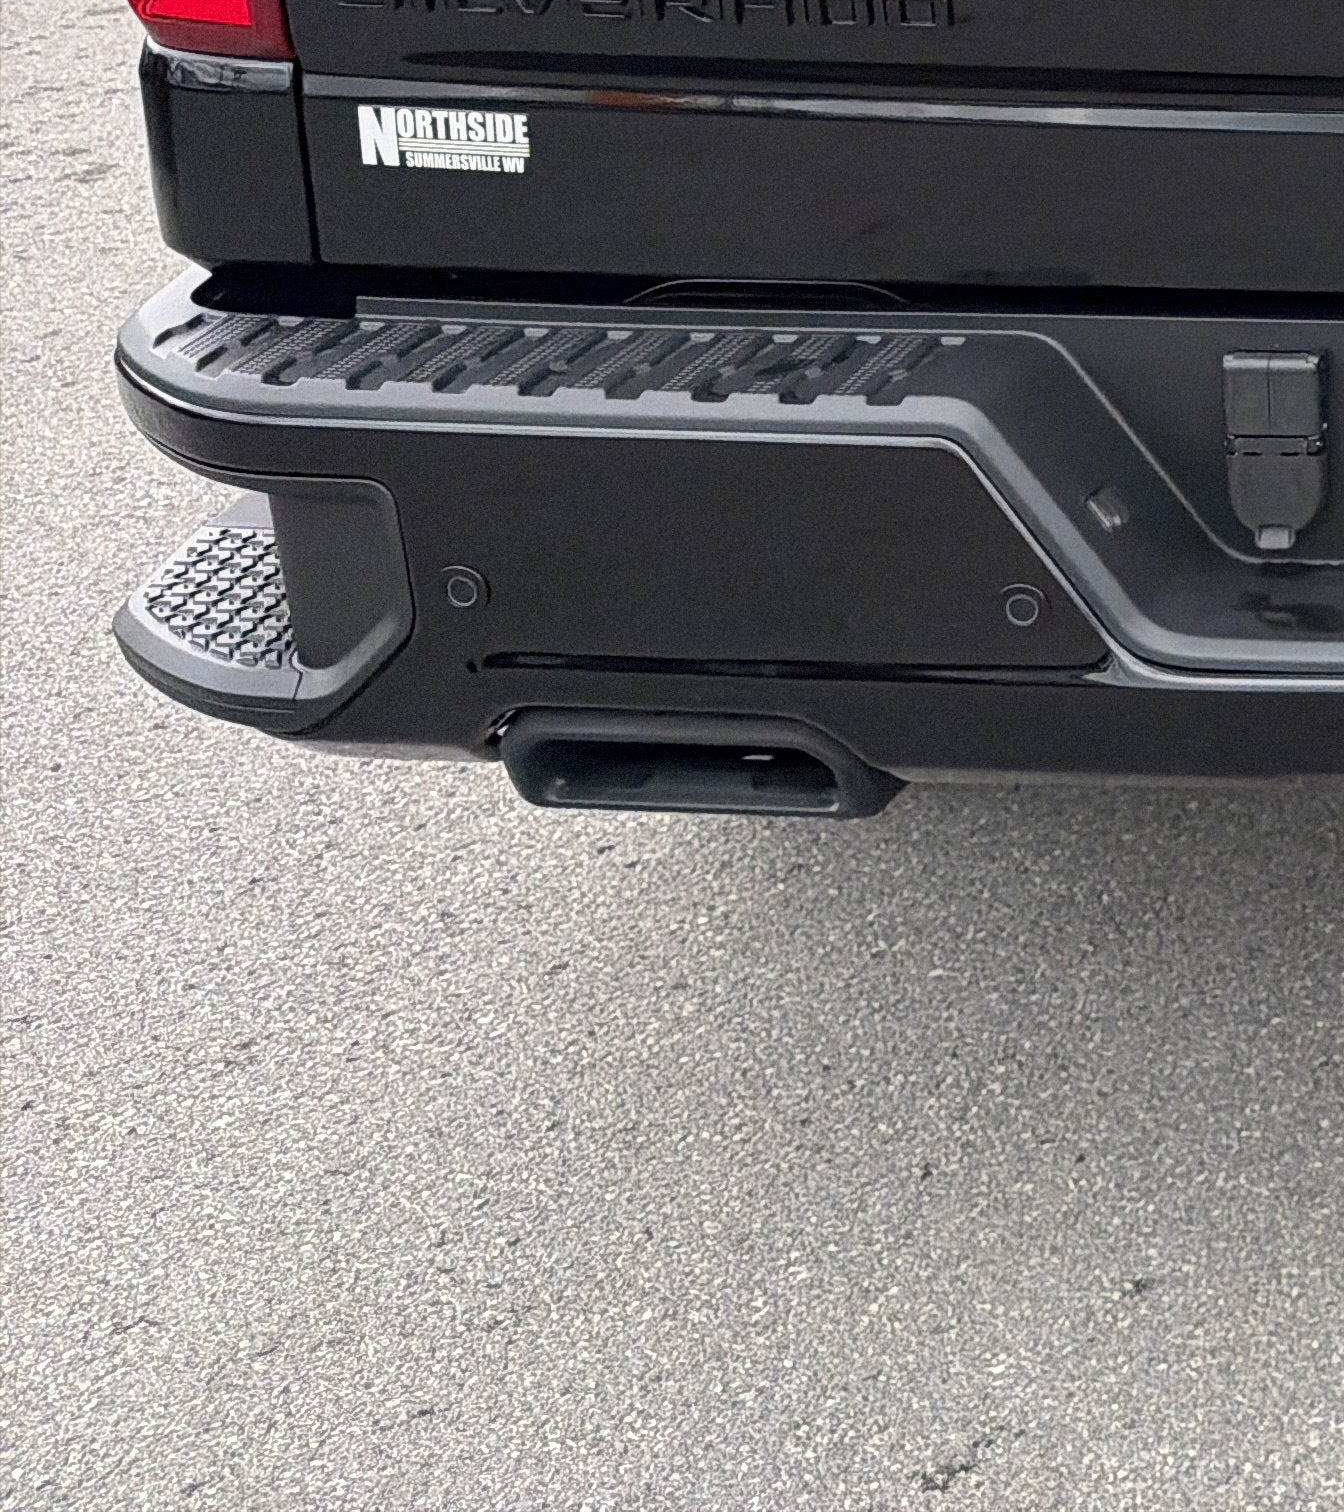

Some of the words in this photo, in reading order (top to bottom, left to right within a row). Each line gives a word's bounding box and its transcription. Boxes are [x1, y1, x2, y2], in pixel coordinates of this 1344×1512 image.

[357, 104, 530, 167] NORTHSIDE
[405, 151, 501, 172] SUMMERSVILLE
[501, 156, 525, 174] WV
